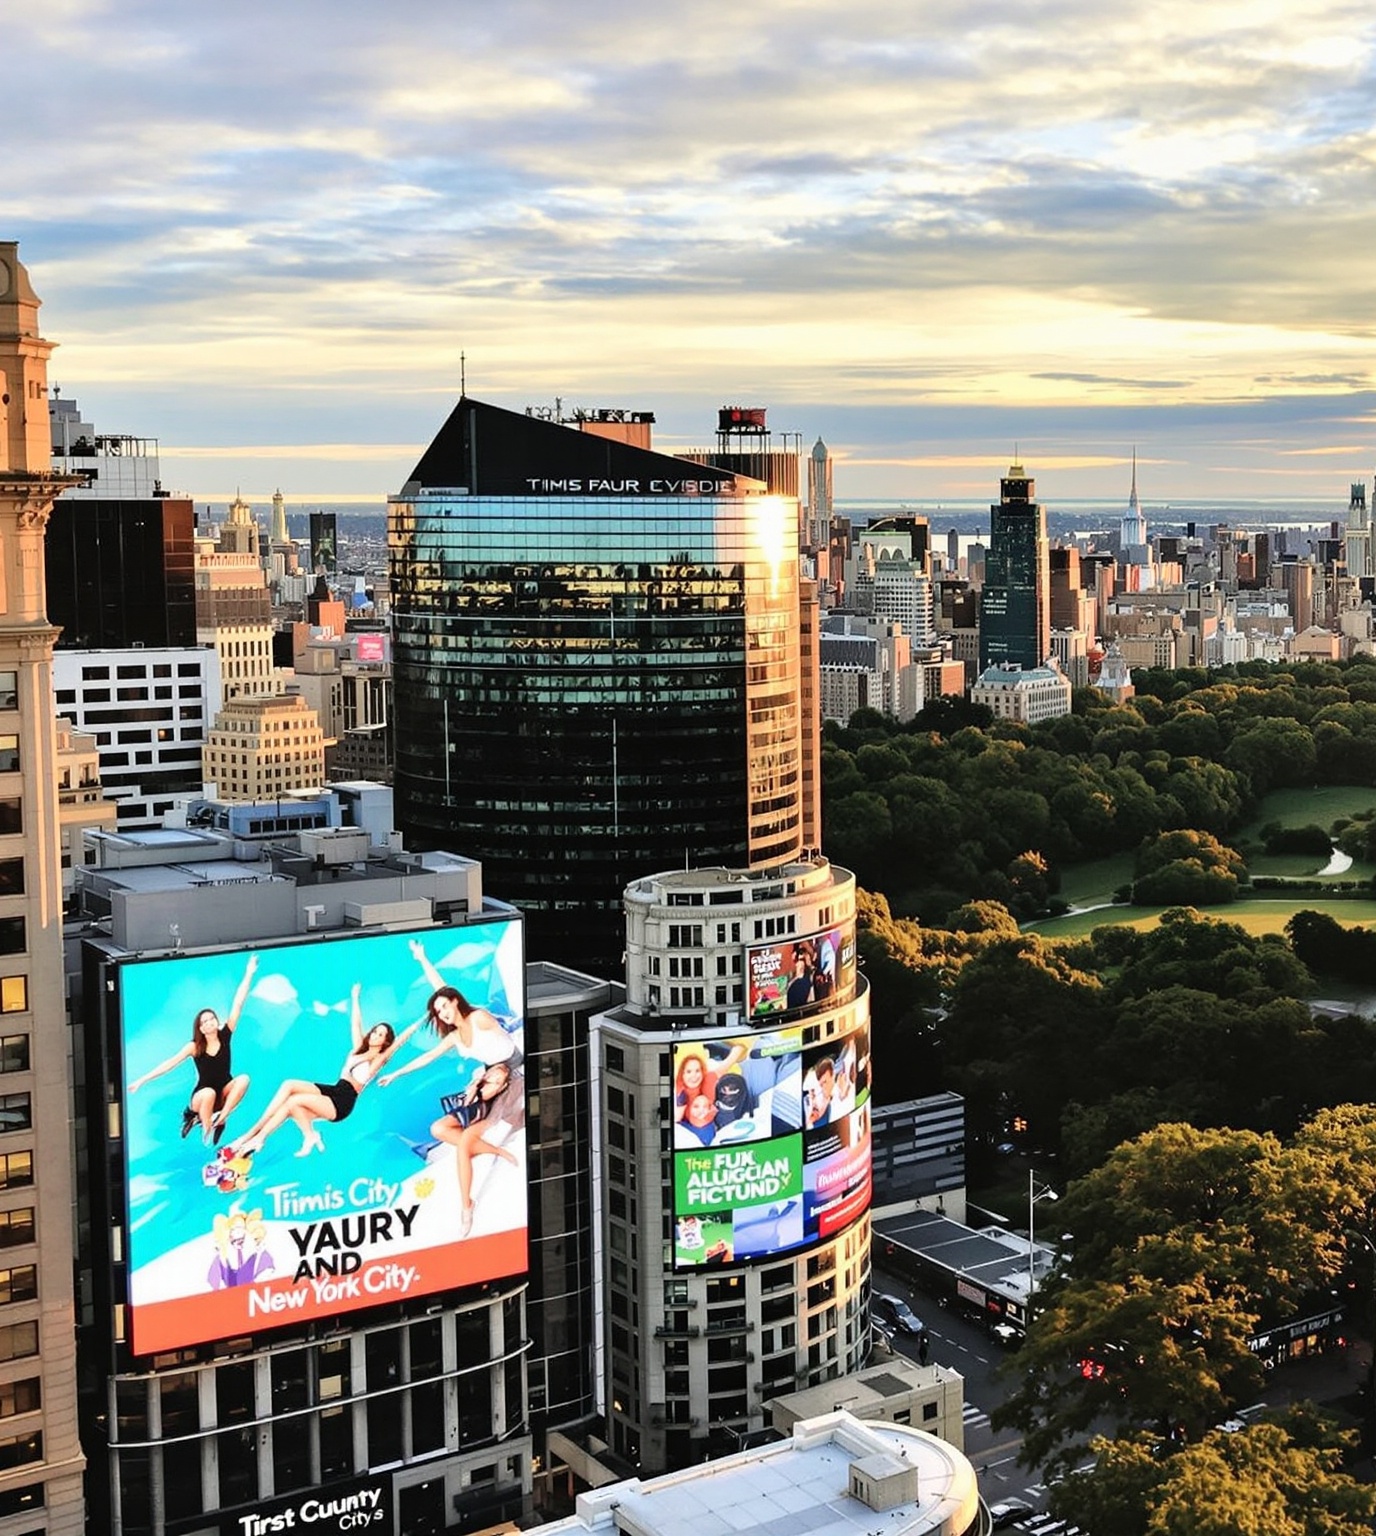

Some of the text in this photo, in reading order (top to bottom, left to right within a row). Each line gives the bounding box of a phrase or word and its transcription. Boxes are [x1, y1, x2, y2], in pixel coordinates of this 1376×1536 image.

[589, 479, 640, 493] FAUR
[348, 1177, 399, 1208] City
[288, 1204, 420, 1257] YAURY
[293, 1252, 362, 1284] AND
[249, 1287, 308, 1317] New
[310, 1276, 360, 1304] York
